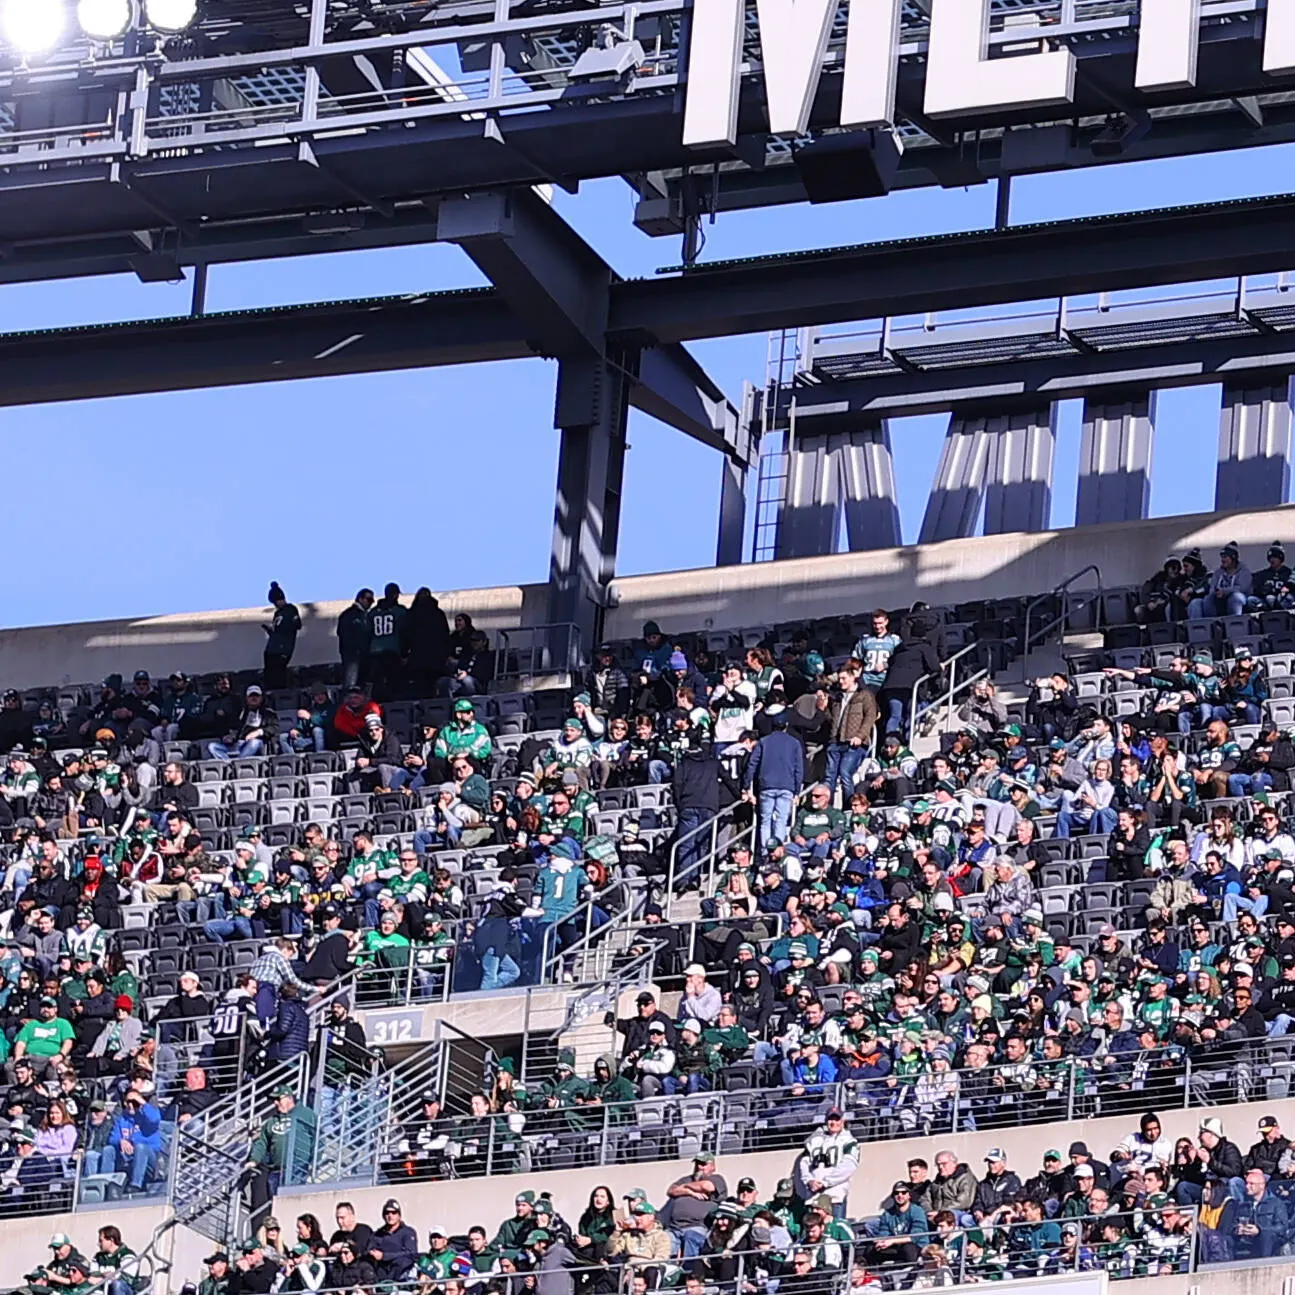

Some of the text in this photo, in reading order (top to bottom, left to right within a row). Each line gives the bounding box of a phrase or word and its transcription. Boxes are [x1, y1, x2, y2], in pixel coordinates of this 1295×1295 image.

[373, 615, 394, 636] 86
[554, 875, 564, 898] 1
[373, 1019, 413, 1043] 312
